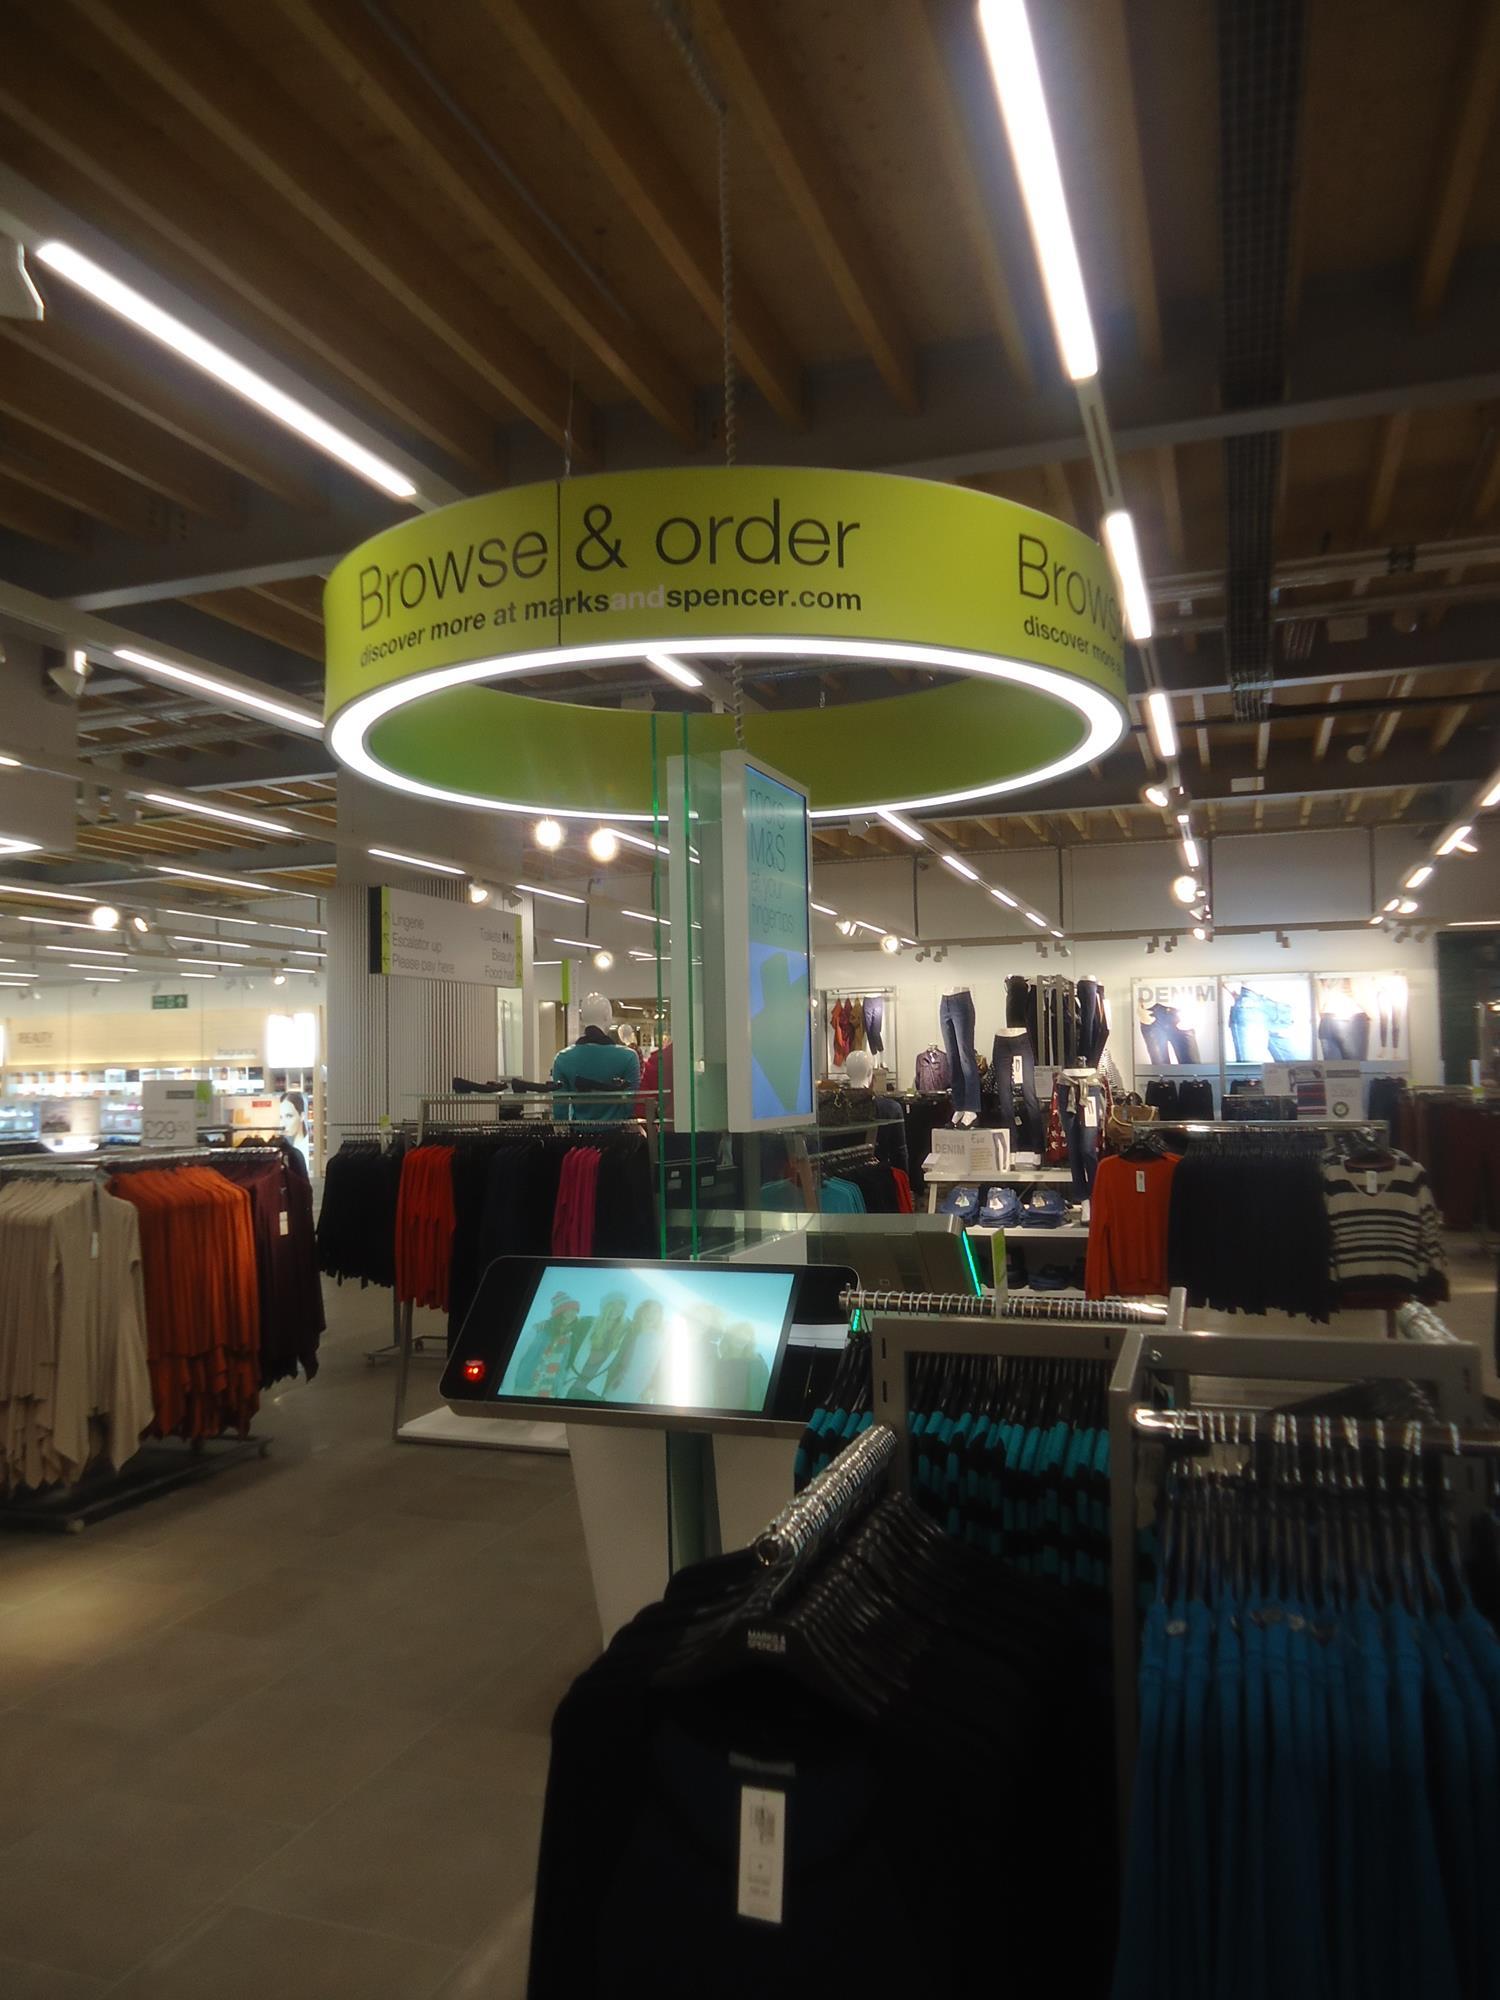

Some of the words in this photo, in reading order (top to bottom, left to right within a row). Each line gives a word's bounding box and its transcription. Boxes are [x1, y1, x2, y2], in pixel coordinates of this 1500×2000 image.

[359, 530, 549, 631] Browse
[575, 503, 628, 573] &
[655, 498, 860, 568] order
[360, 627, 426, 667] discover
[431, 612, 487, 641] more
[493, 602, 517, 626] at
[524, 585, 862, 623] marksandspencer.com
[1023, 615, 1089, 656] discover
[750, 788, 785, 831] more
[750, 822, 786, 872] M&S
[392, 953, 420, 970] Please
